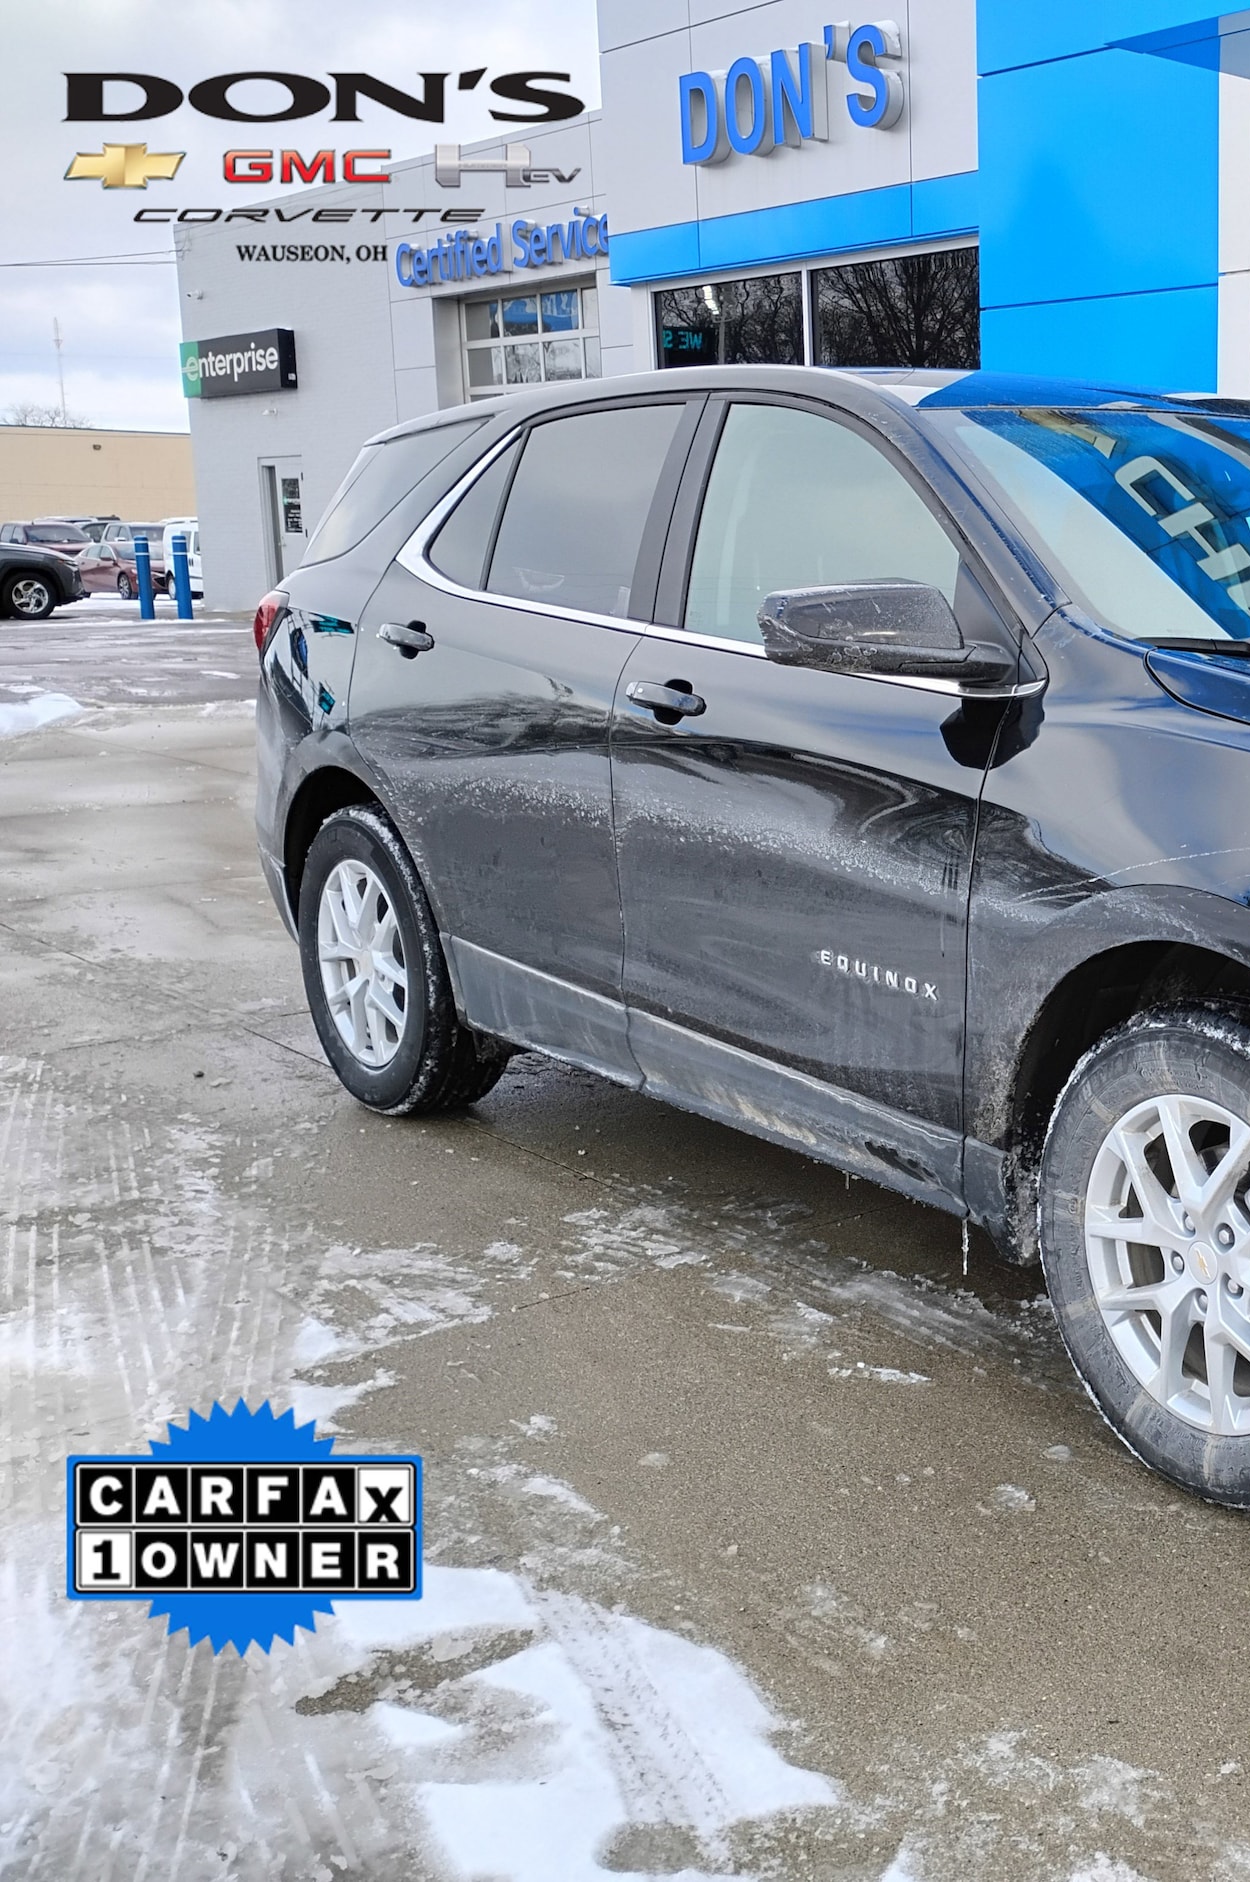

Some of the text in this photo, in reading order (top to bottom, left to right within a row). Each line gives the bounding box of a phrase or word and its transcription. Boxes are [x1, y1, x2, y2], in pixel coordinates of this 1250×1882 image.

[678, 20, 904, 166] DON'S
[396, 222, 501, 288] Certified
[183, 342, 279, 382] enterprise
[820, 949, 938, 1001] EQUINOX
